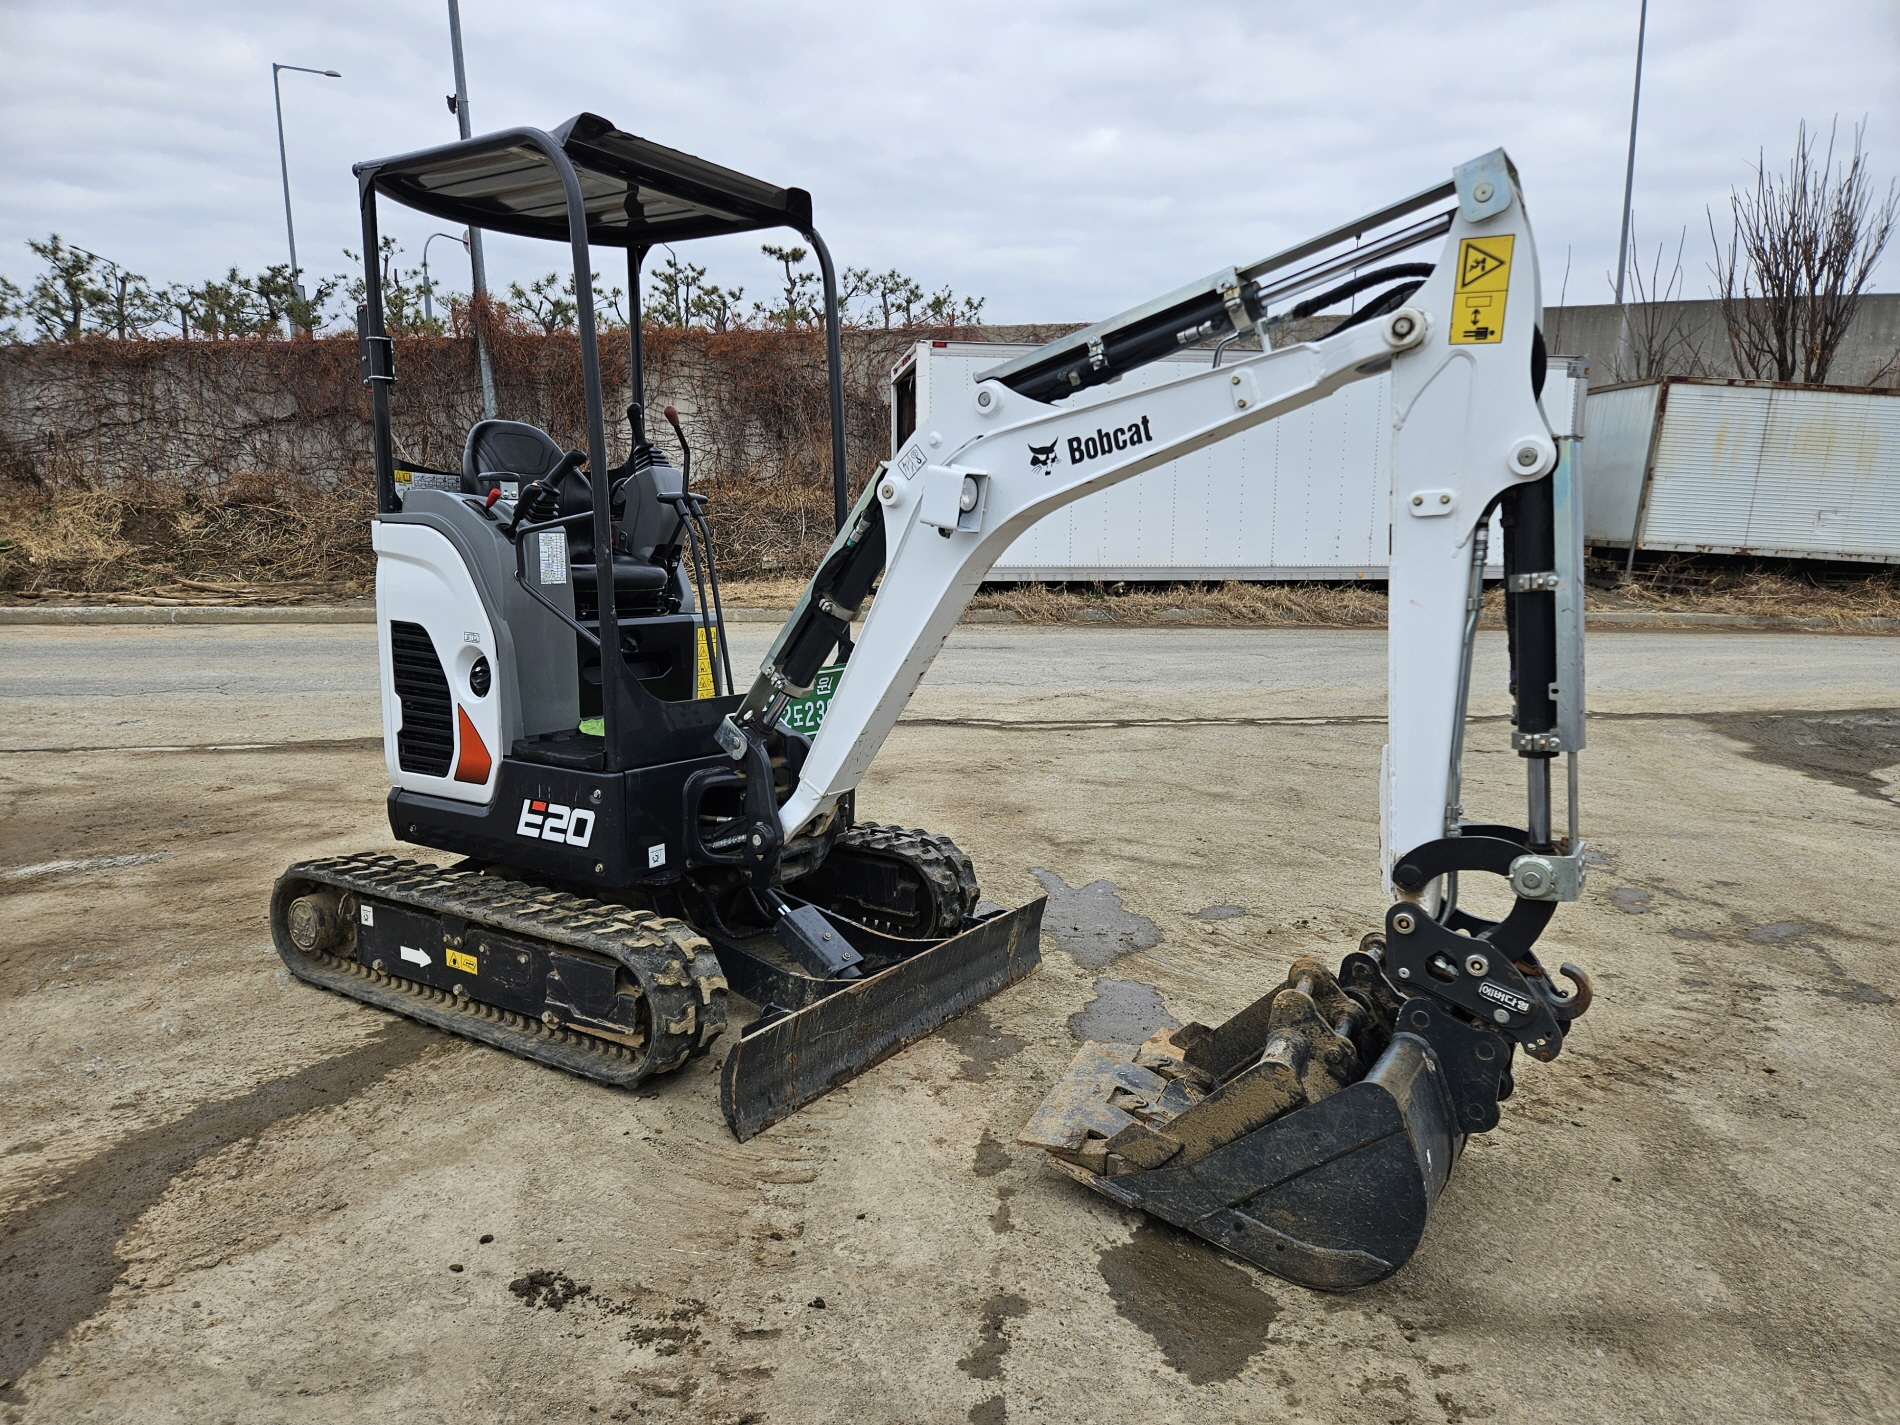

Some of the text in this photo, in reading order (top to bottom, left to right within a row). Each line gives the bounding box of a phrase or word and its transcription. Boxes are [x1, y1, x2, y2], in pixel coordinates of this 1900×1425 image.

[1067, 415, 1153, 465] Bobcat
[780, 698, 833, 727] 2도23
[516, 798, 596, 848] E20
